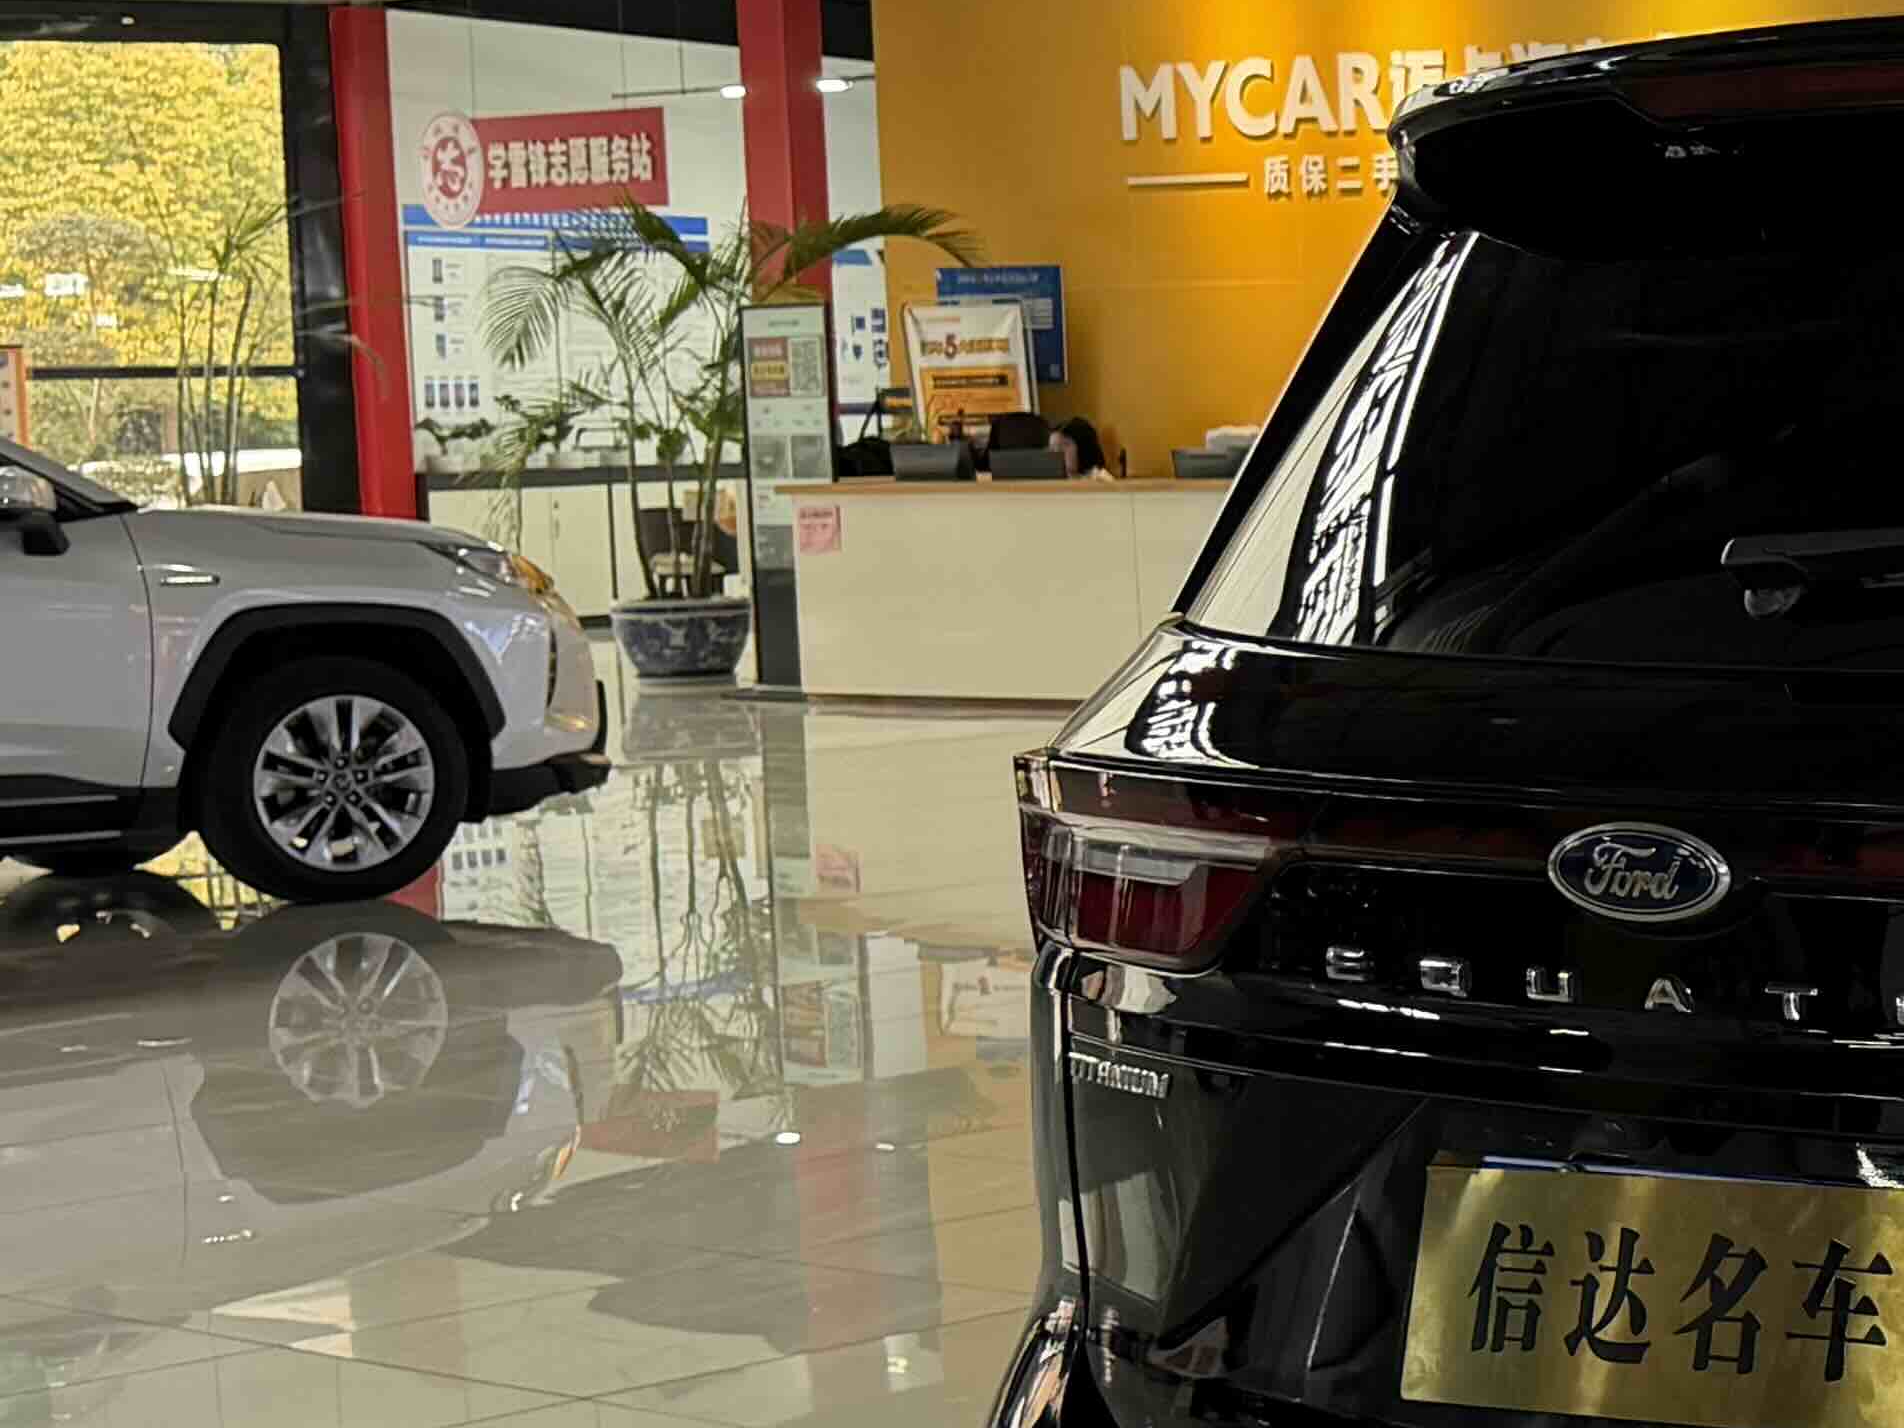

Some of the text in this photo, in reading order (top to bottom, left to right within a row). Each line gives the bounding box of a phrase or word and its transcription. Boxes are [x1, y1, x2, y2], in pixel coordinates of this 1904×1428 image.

[486, 132, 654, 189] 学雷锋志愿服务站
[1582, 841, 1681, 902] Ford
[1466, 1220, 1896, 1383] 信达名车
